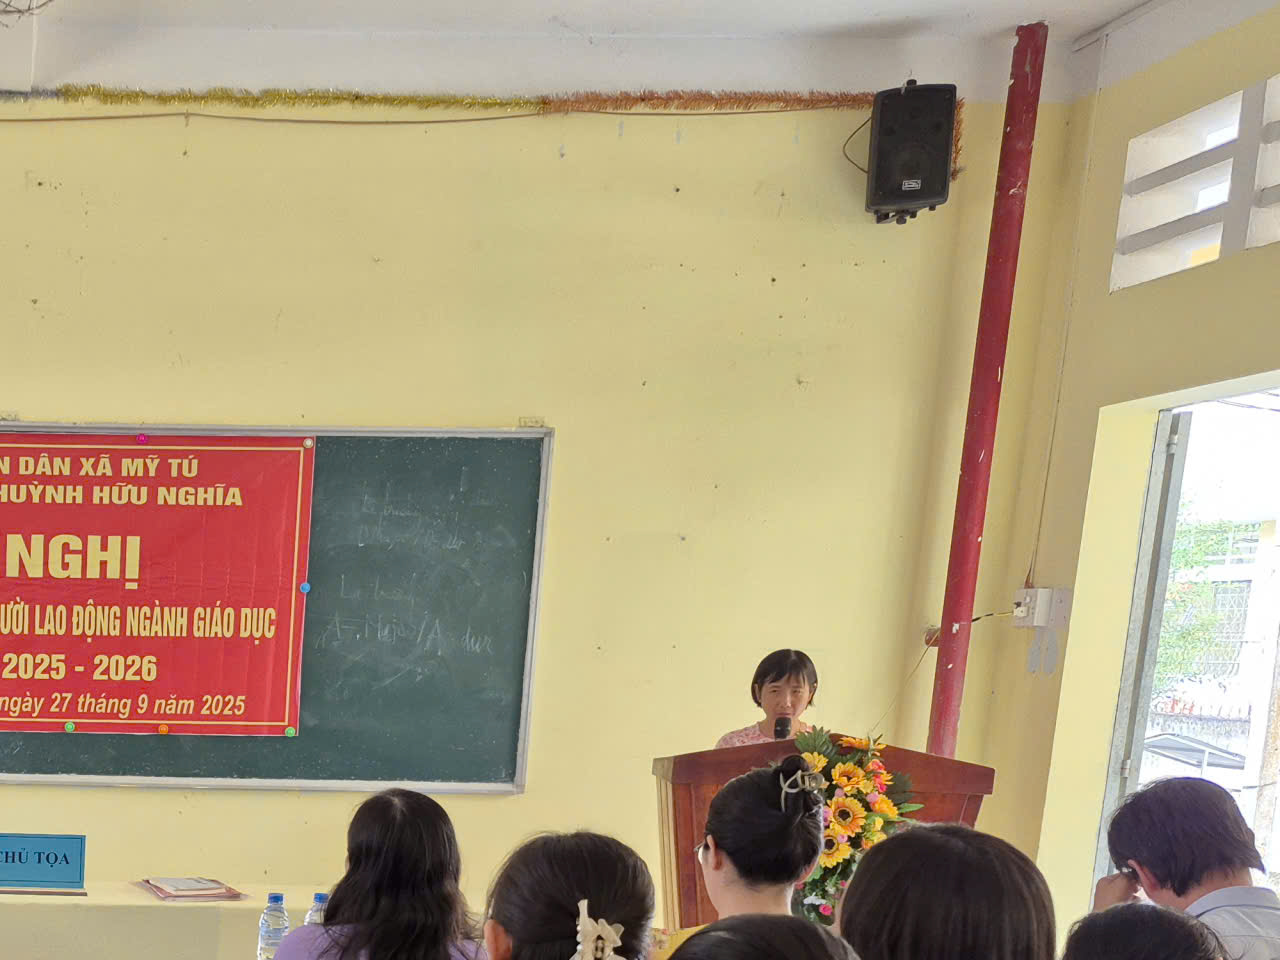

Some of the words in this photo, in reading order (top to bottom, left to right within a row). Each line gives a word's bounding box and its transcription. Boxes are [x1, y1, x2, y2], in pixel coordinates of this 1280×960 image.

[19, 453, 71, 476] DÂN
[79, 454, 113, 477] XÃ
[121, 454, 161, 477] MỸ
[167, 455, 199, 478] TÚ
[92, 482, 148, 505] HỮU
[157, 483, 243, 506] NGHĨA
[5, 533, 141, 590] NGHỊ
[34, 604, 67, 636] LAO
[71, 598, 121, 643] ĐỘNG
[125, 599, 188, 637] NGÀNH
[192, 600, 235, 638] GIÁO
[239, 607, 277, 645] DỤC
[1, 652, 66, 680] 2025
[92, 654, 157, 682] 2026
[49, 692, 73, 713] 27
[77, 693, 132, 718] tháng
[137, 693, 149, 714] 9
[153, 694, 195, 715] năm
[200, 694, 246, 716] 2025
[34, 851, 70, 868] TỌA
